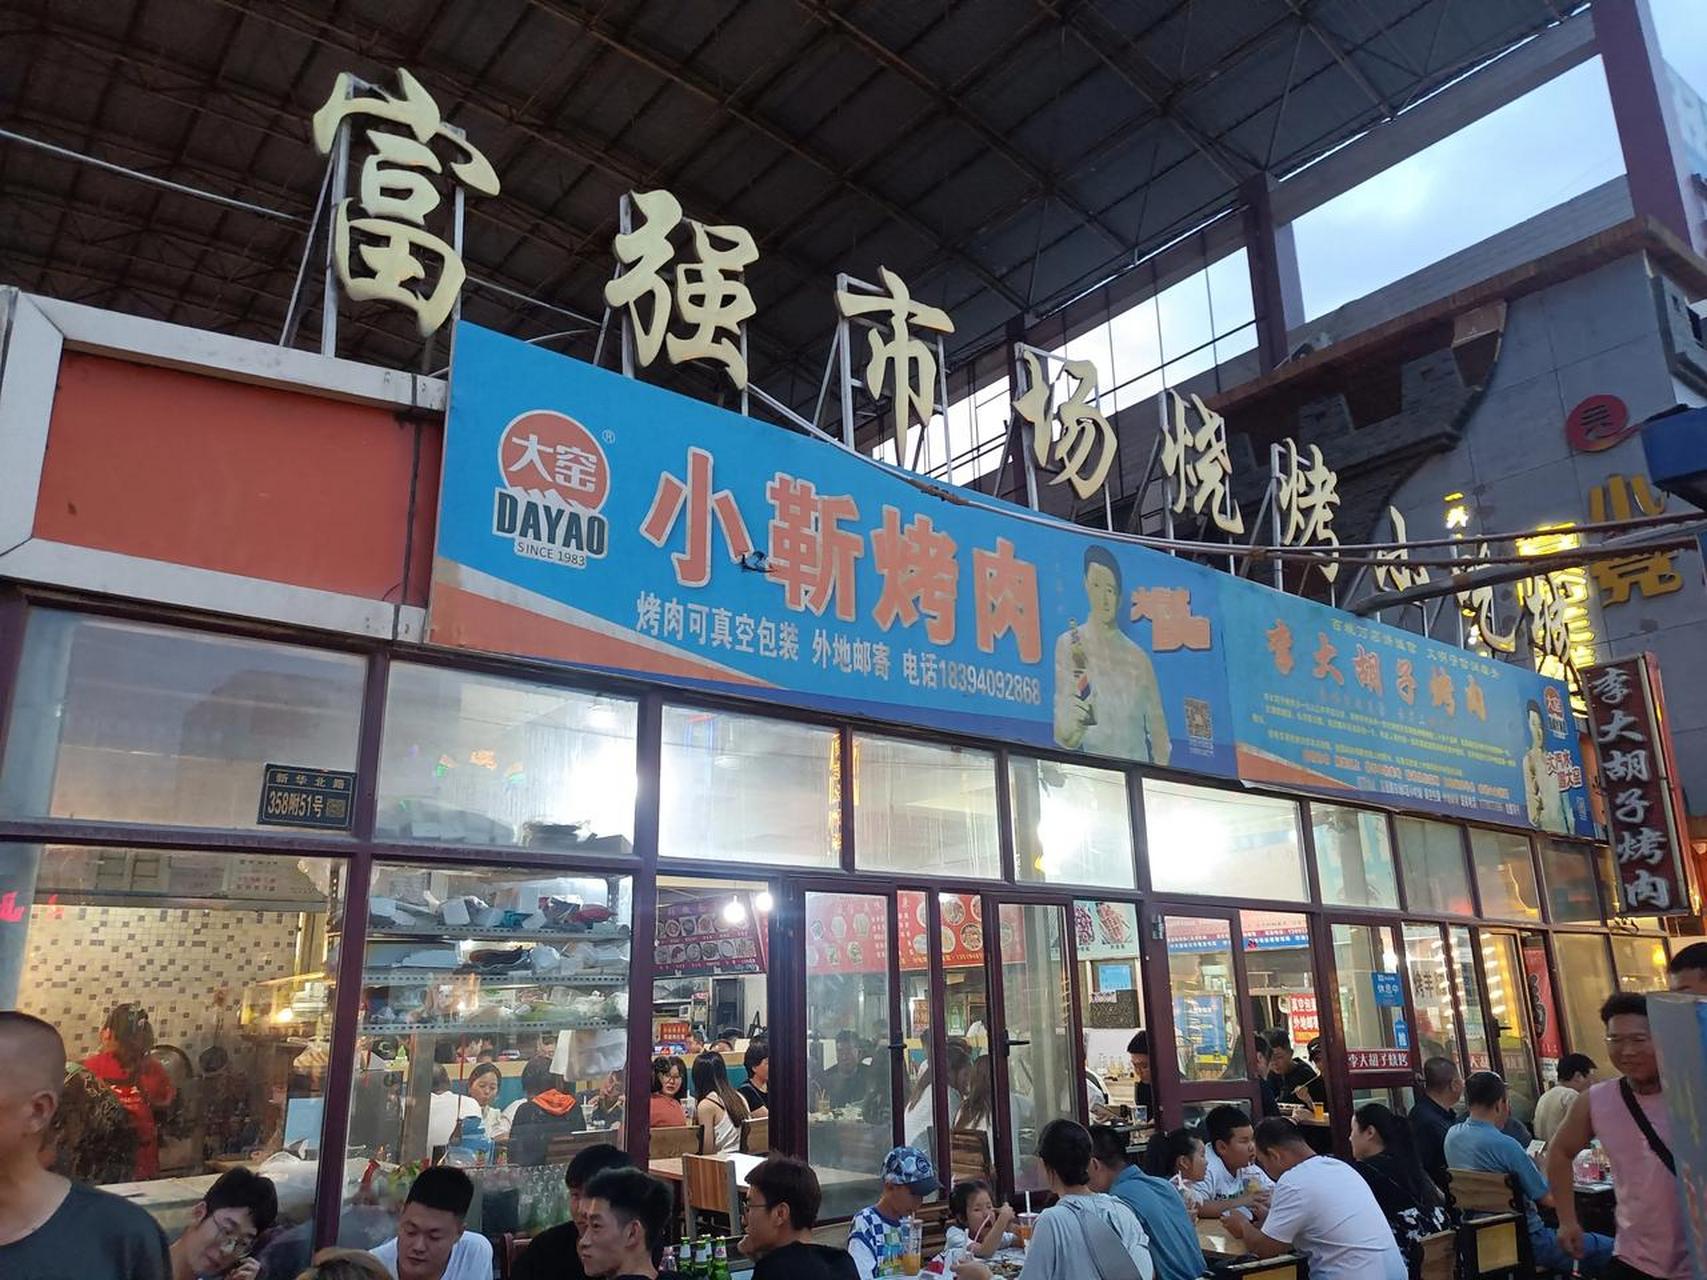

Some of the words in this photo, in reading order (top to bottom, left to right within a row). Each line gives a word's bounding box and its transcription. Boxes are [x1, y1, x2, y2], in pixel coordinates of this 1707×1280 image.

[508, 434, 597, 492] 大窑
[496, 492, 606, 556] DAYAO
[517, 541, 554, 559] SINCE
[558, 550, 585, 567] 1983
[640, 446, 1042, 664] 小靳烤肉
[636, 591, 799, 661] 烤肉可真空包装
[812, 629, 891, 682] 外地邮寄
[267, 790, 324, 818] 358附51号
[1592, 667, 1670, 909] 李大胡子烤肉
